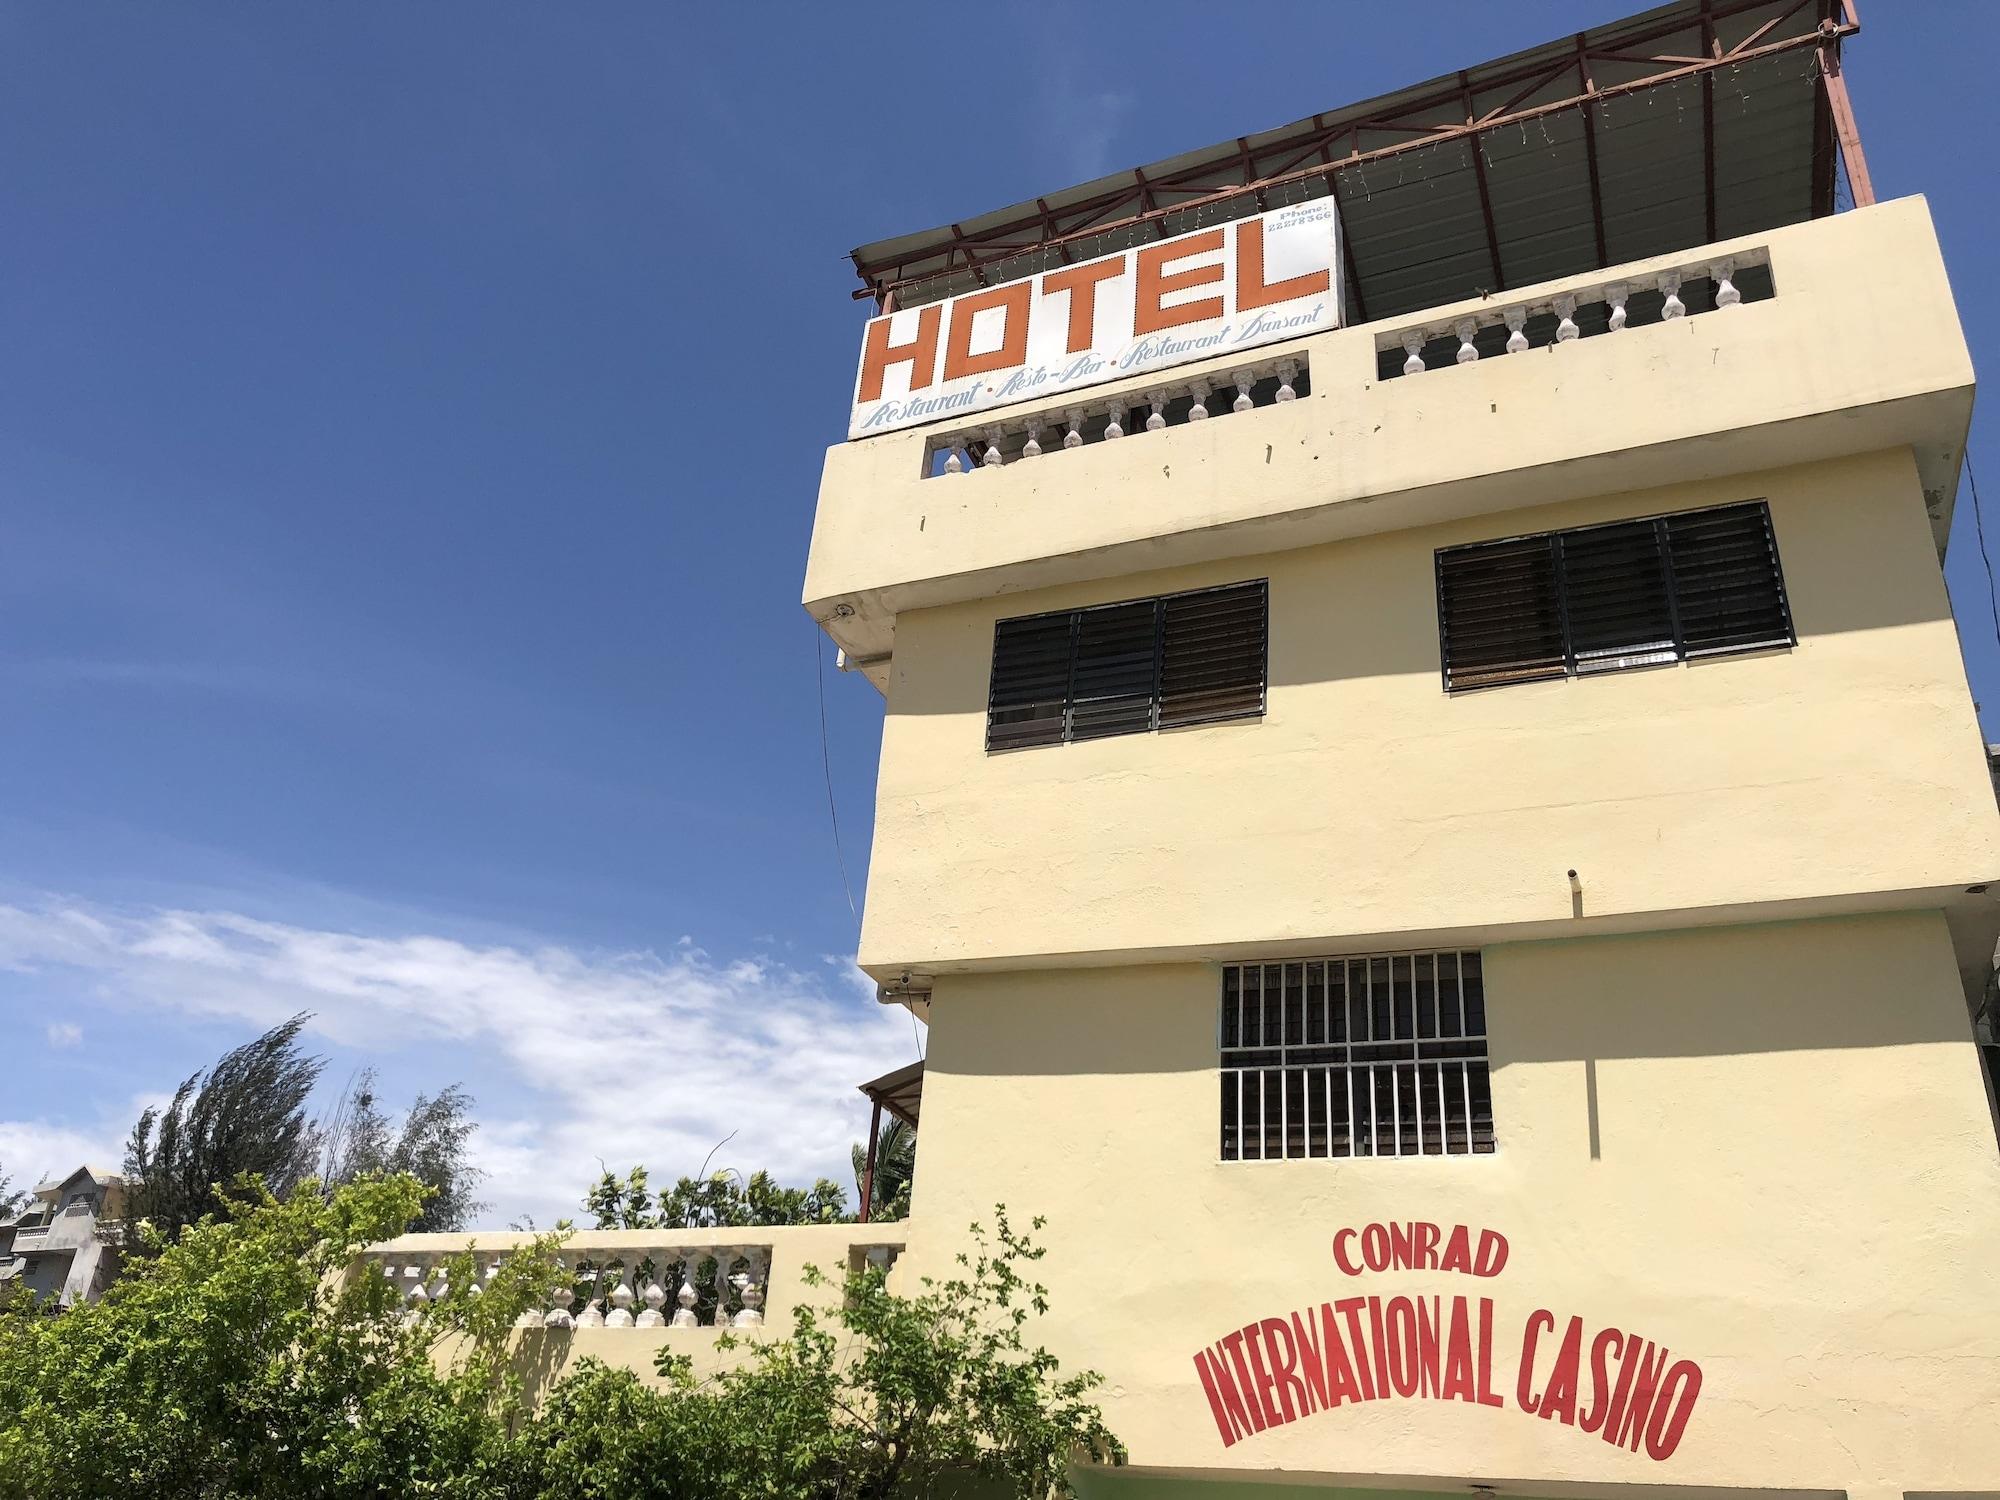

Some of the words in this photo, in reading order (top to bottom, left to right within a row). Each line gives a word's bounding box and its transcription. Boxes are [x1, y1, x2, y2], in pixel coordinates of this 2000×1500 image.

[1280, 203, 1328, 220] Phone:
[857, 217, 1330, 404] HOTEL
[861, 381, 984, 428] Restaurant
[1120, 325, 1232, 369] Restaurant
[1232, 303, 1325, 344] Dansant
[1333, 1221, 1509, 1278] CONRAD
[1193, 1295, 1504, 1448] INTERNATIONAL
[1517, 1309, 1702, 1461] CASINO
